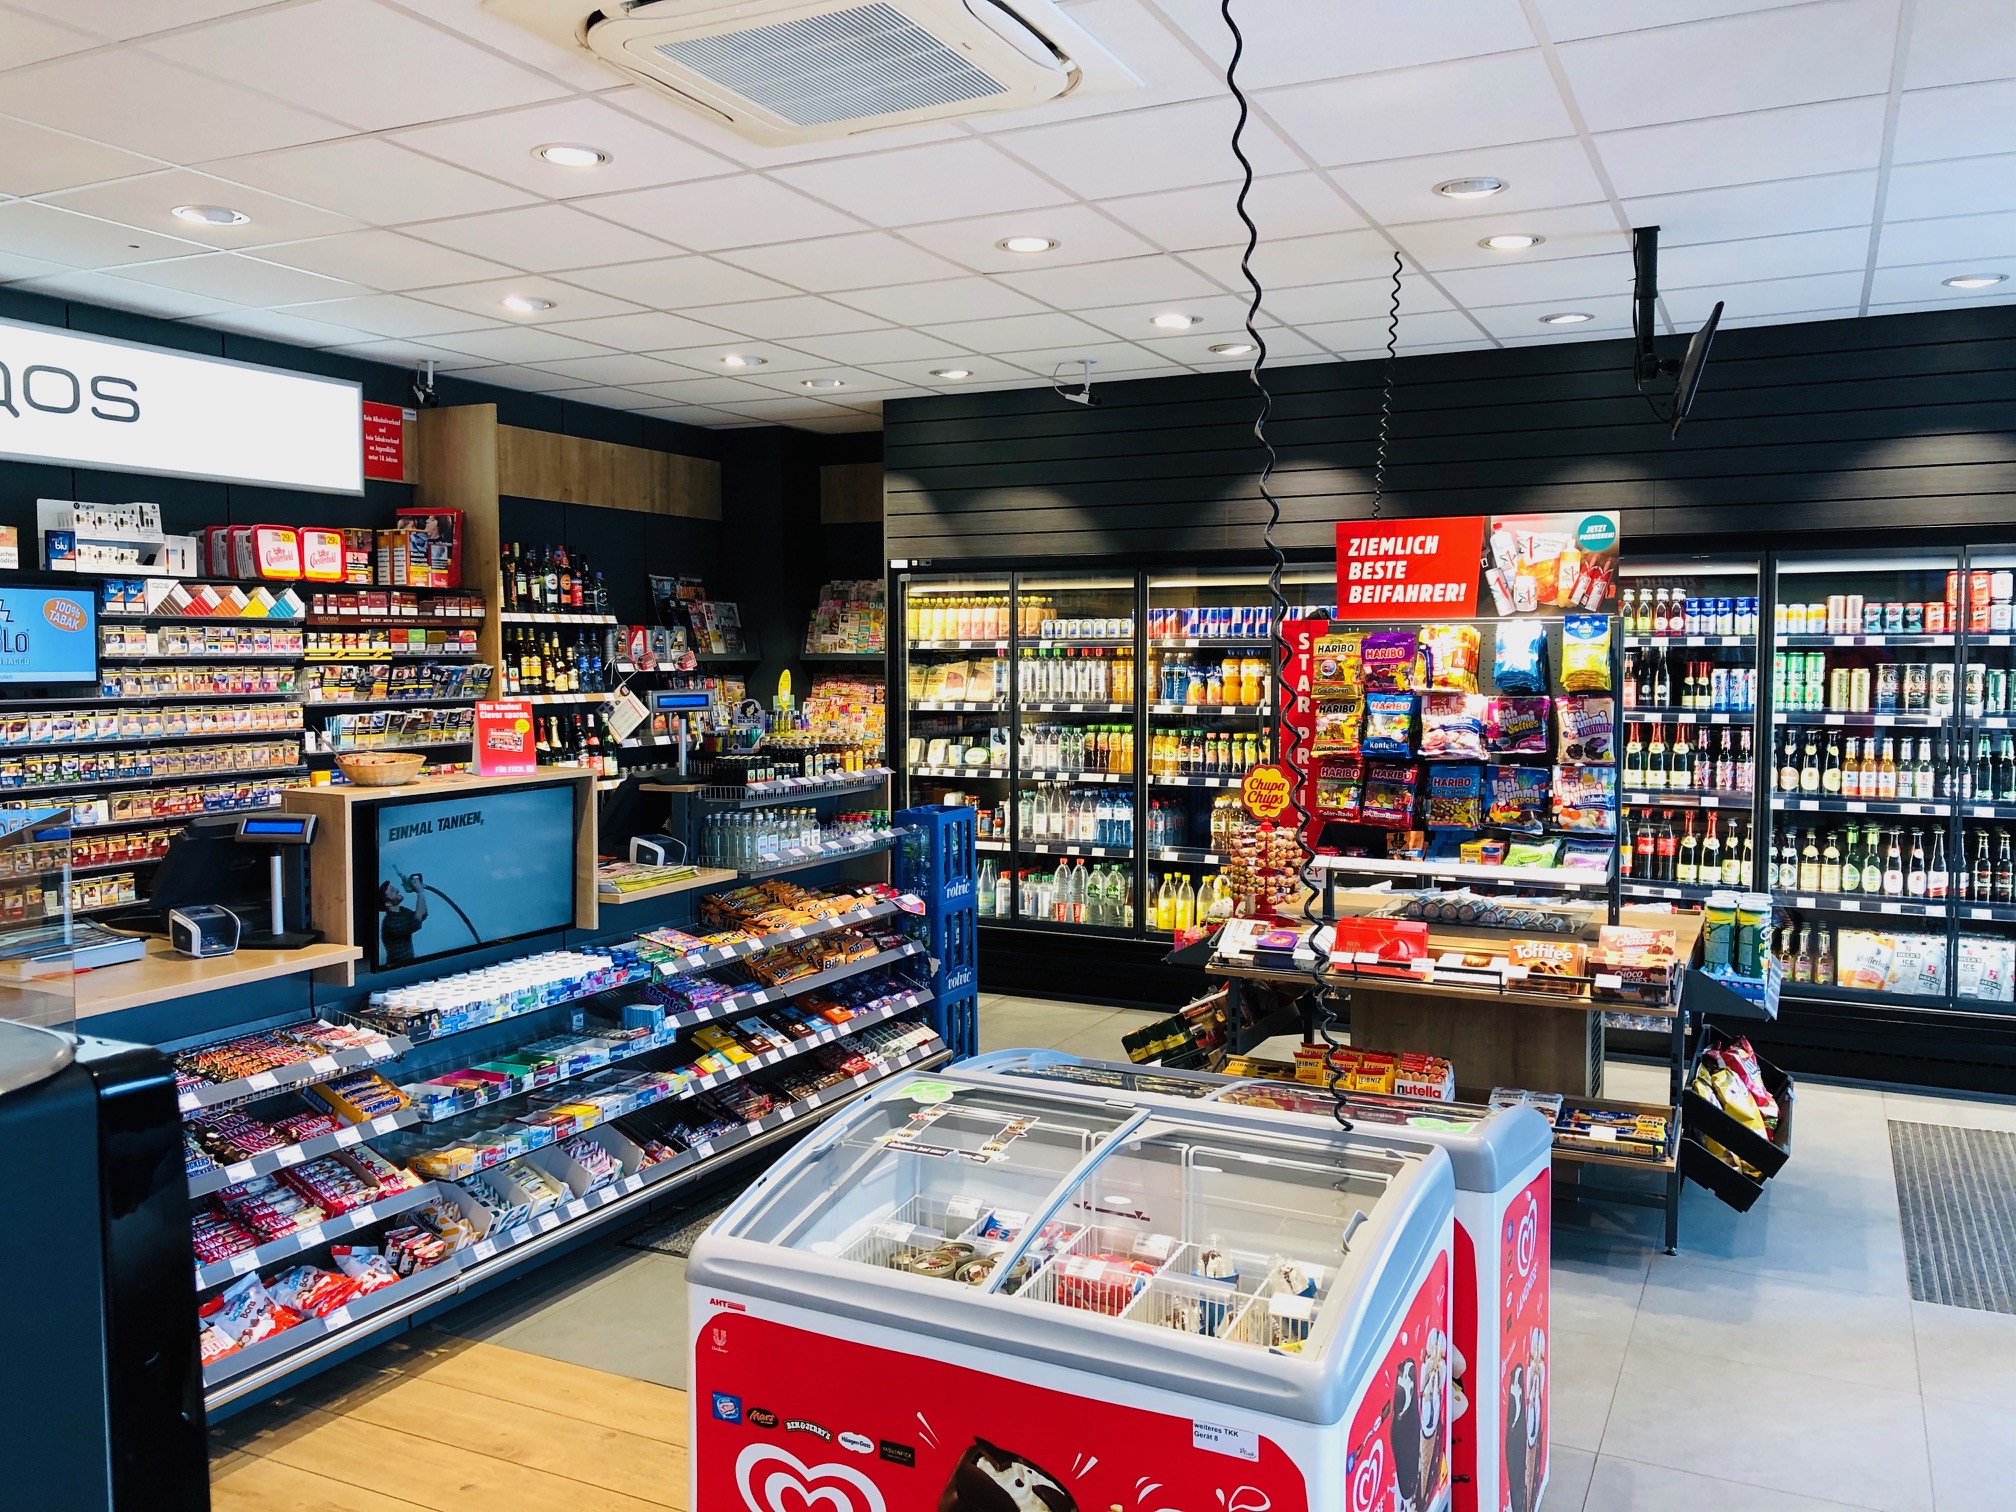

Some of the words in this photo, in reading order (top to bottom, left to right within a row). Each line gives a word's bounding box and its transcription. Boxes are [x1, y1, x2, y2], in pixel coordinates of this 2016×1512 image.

[1586, 524, 1608, 534] JETZT
[1579, 532, 1615, 541] PROBIEREN!
[1347, 535, 1440, 557] ZIEMLICH
[1348, 560, 1407, 580] BESTE
[1348, 583, 1467, 604] BEIFAHRER!
[55, 600, 81, 618] 100%
[49, 609, 80, 630] TABAK
[1317, 644, 1355, 654] HARIBO
[1365, 647, 1406, 660] HARIBO
[1297, 632, 1310, 714] STAR
[1319, 704, 1357, 714] HARIBO
[1370, 701, 1411, 711] HARIBO
[480, 711, 502, 719] Clever
[1320, 766, 1360, 779] HARIBO
[1371, 768, 1412, 781] HARIBO
[1249, 778, 1286, 796] Chupa
[1432, 776, 1472, 788] HARIBO
[1247, 790, 1284, 811] Chups
[389, 820, 434, 842] EINMAL
[437, 810, 485, 832] TANKEN,
[1567, 845, 1609, 854] Em-eukal
[946, 880, 970, 899] volvic
[1512, 942, 1574, 963] Toffifee
[948, 967, 972, 990] volvic
[1922, 981, 1935, 990] ICE
[1983, 986, 1996, 994] ICE
[646, 985, 689, 1013] mentos
[1296, 1059, 1320, 1068] LEIBNIZ
[1358, 1075, 1382, 1084] LEIBNIZ
[1397, 1083, 1442, 1099] nutella
[240, 1300, 257, 1319] Bons
[709, 1297, 728, 1308] AHT
[749, 1409, 776, 1423] Mars
[1193, 1422, 1223, 1434] weiteres
[1224, 1428, 1240, 1438] TKK
[1193, 1430, 1213, 1441] Gerät
[1214, 1434, 1219, 1442] 8
[841, 1435, 872, 1449] Häagen-Dazs
